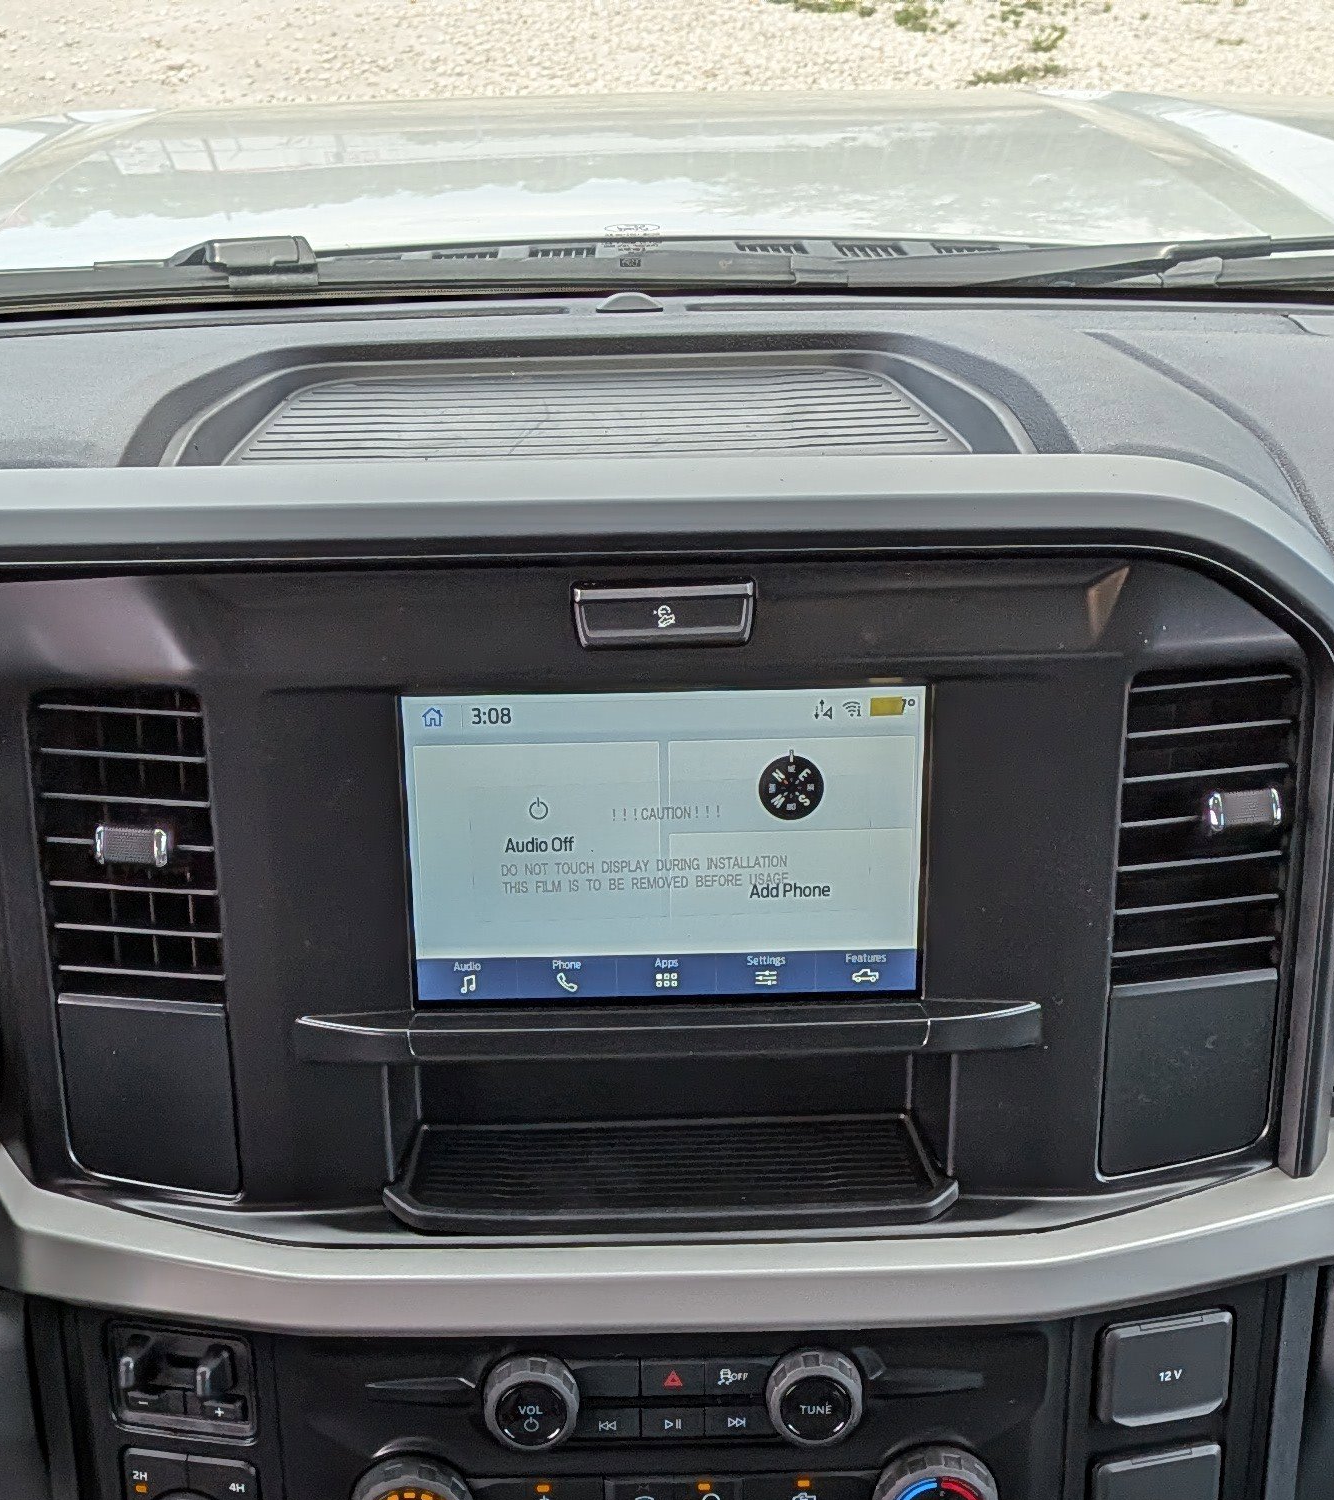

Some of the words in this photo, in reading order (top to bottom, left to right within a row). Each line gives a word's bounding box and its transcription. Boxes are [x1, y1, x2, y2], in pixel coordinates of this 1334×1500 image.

[471, 707, 512, 726] 3:08
[504, 837, 548, 853] Audio
[551, 835, 576, 852] Off
[501, 864, 518, 878] DO
[524, 863, 549, 877] NOT
[555, 861, 595, 876] TOUCH
[601, 859, 650, 874] DISPLAY
[656, 858, 700, 872] DURING
[706, 855, 788, 871] INSTALLATION
[502, 881, 530, 894] THIS
[535, 880, 562, 893] FILM
[569, 879, 580, 893] IS
[587, 878, 602, 892] TO
[608, 878, 625, 891] BE
[631, 875, 690, 890] REMOVED
[695, 874, 743, 889] BEFORE
[749, 882, 780, 899] Add
[782, 881, 832, 898] Phone
[552, 958, 582, 971] Phone
[654, 956, 679, 970] Apps
[746, 954, 787, 968] Settings
[845, 952, 888, 965] Features
[453, 960, 482, 972] Audio
[730, 1371, 749, 1381] OFF
[1159, 1371, 1172, 1382] 12
[1173, 1369, 1183, 1380] V
[518, 1405, 544, 1416] VOL
[799, 1404, 833, 1415] TUNE
[131, 1469, 148, 1481] 2H
[228, 1482, 246, 1493] 4H
